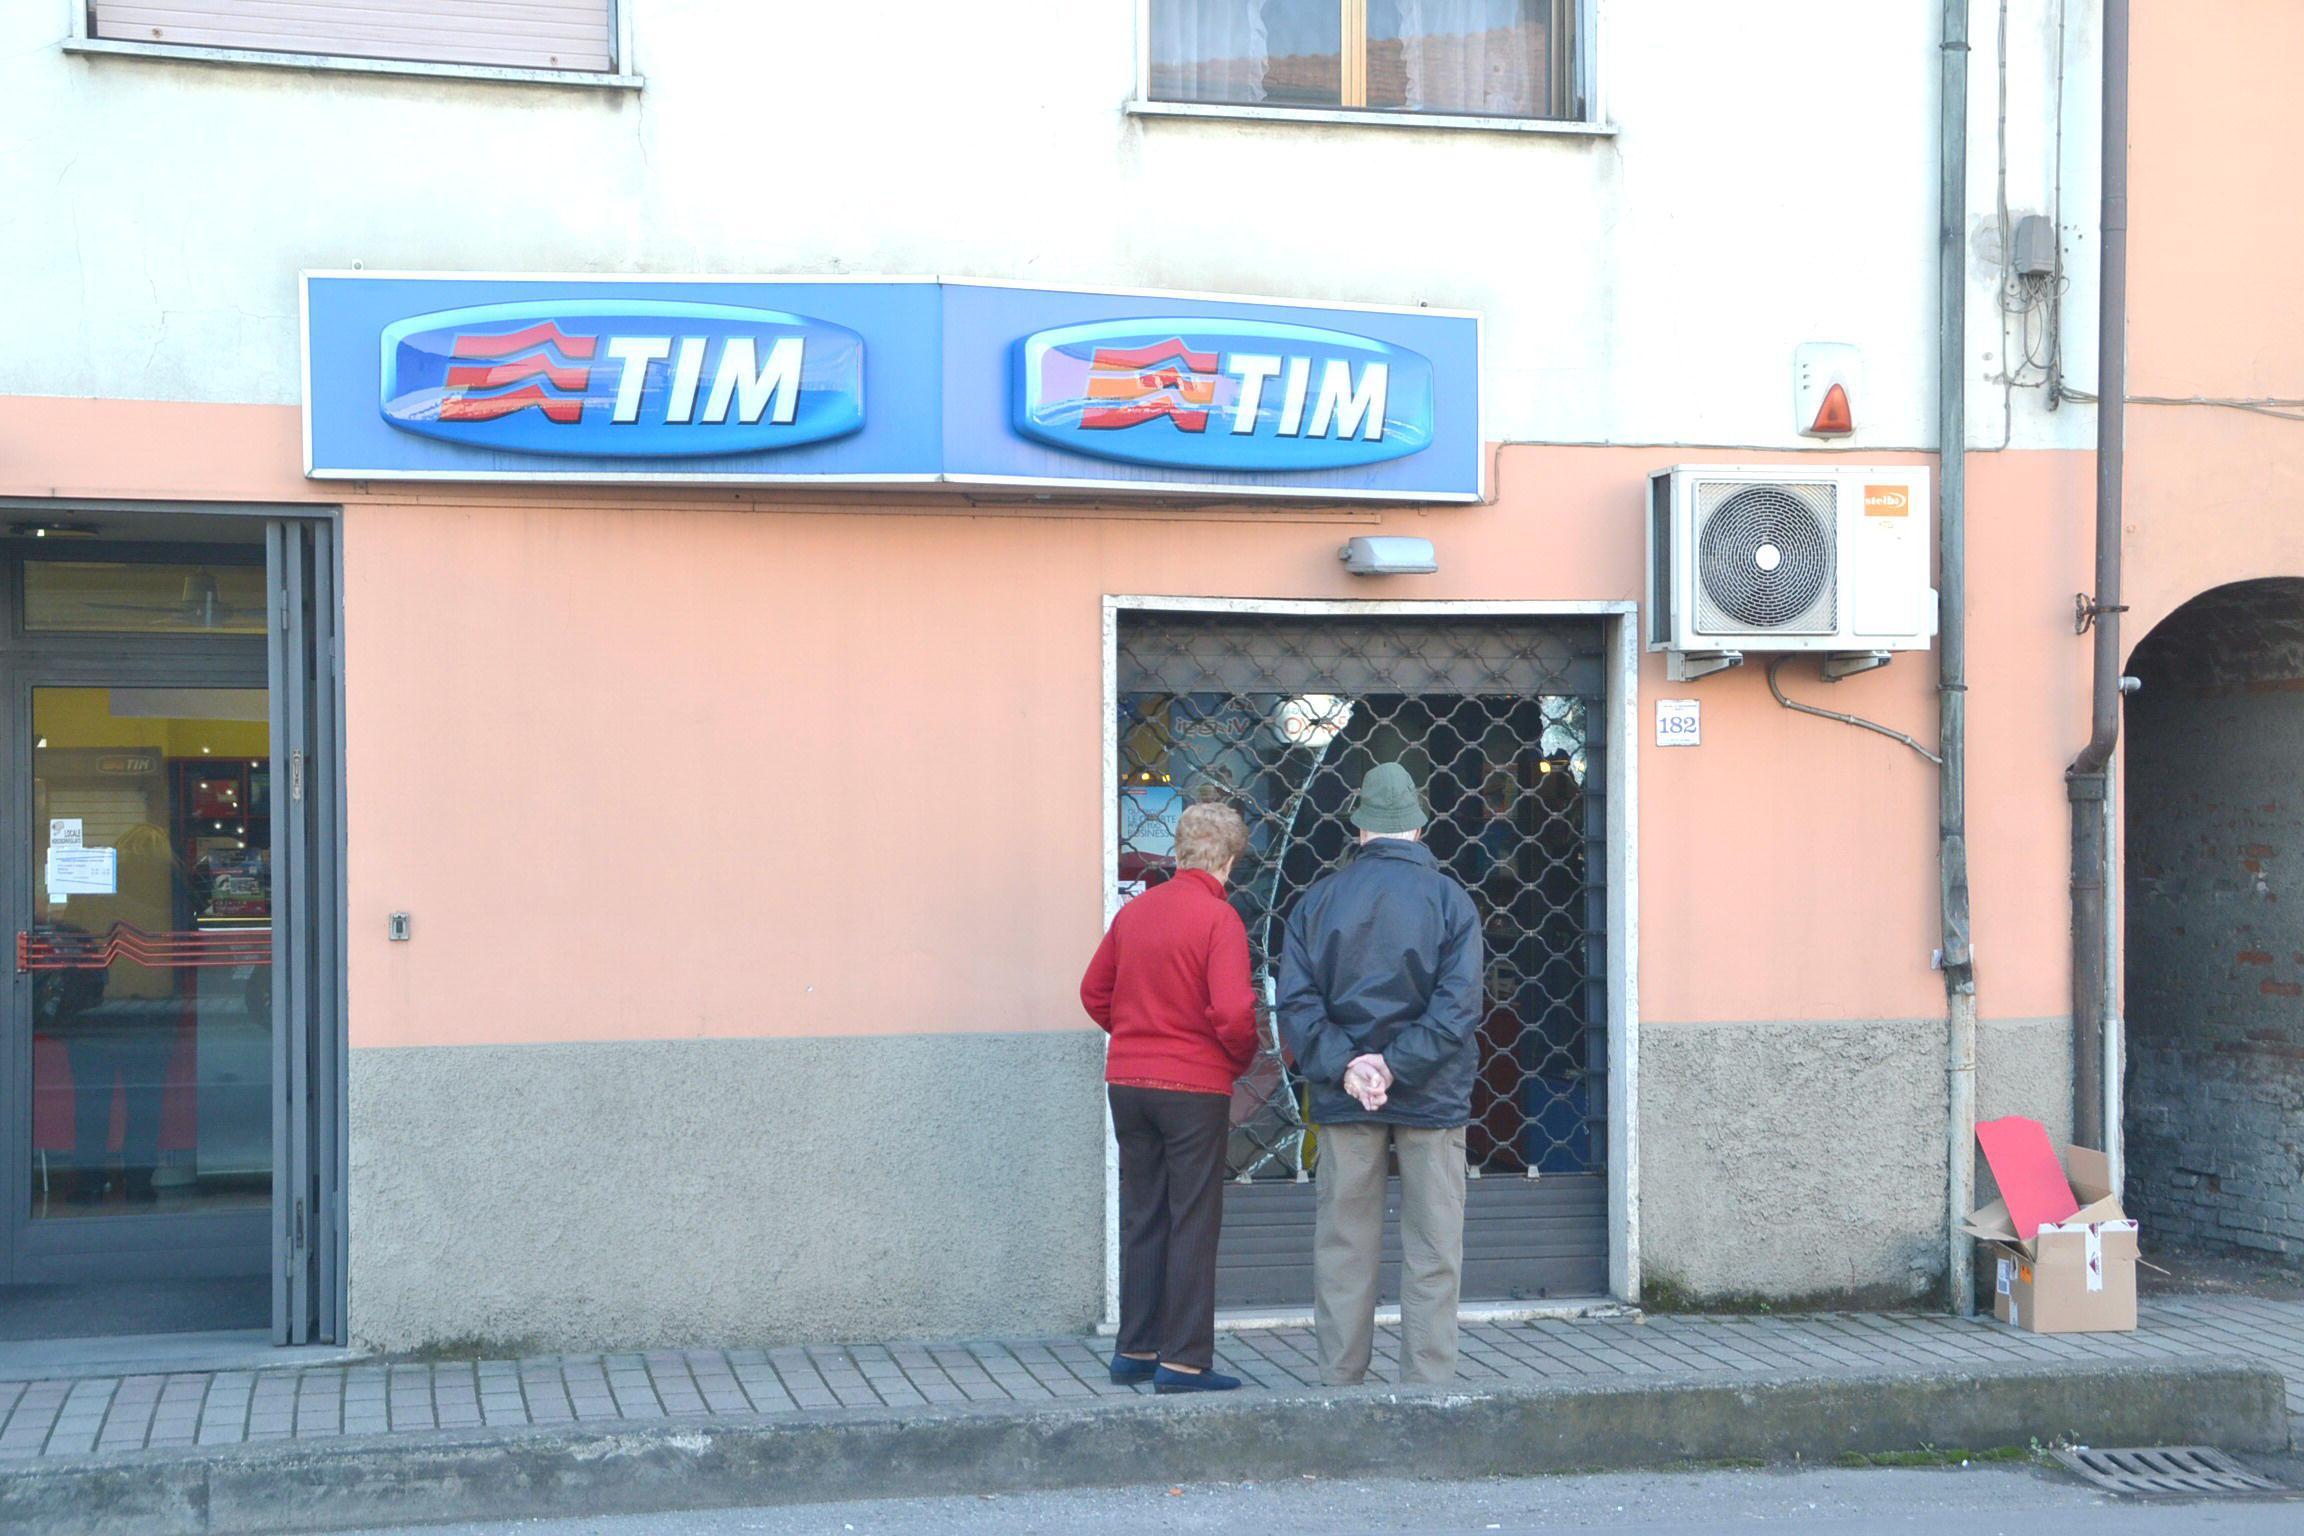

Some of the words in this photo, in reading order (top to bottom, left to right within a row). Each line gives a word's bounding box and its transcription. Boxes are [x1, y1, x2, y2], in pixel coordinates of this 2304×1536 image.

[607, 335, 806, 425] TIM
[1227, 352, 1390, 442] TIM
[1659, 716, 1697, 734] 182
[127, 759, 150, 770] TIM
